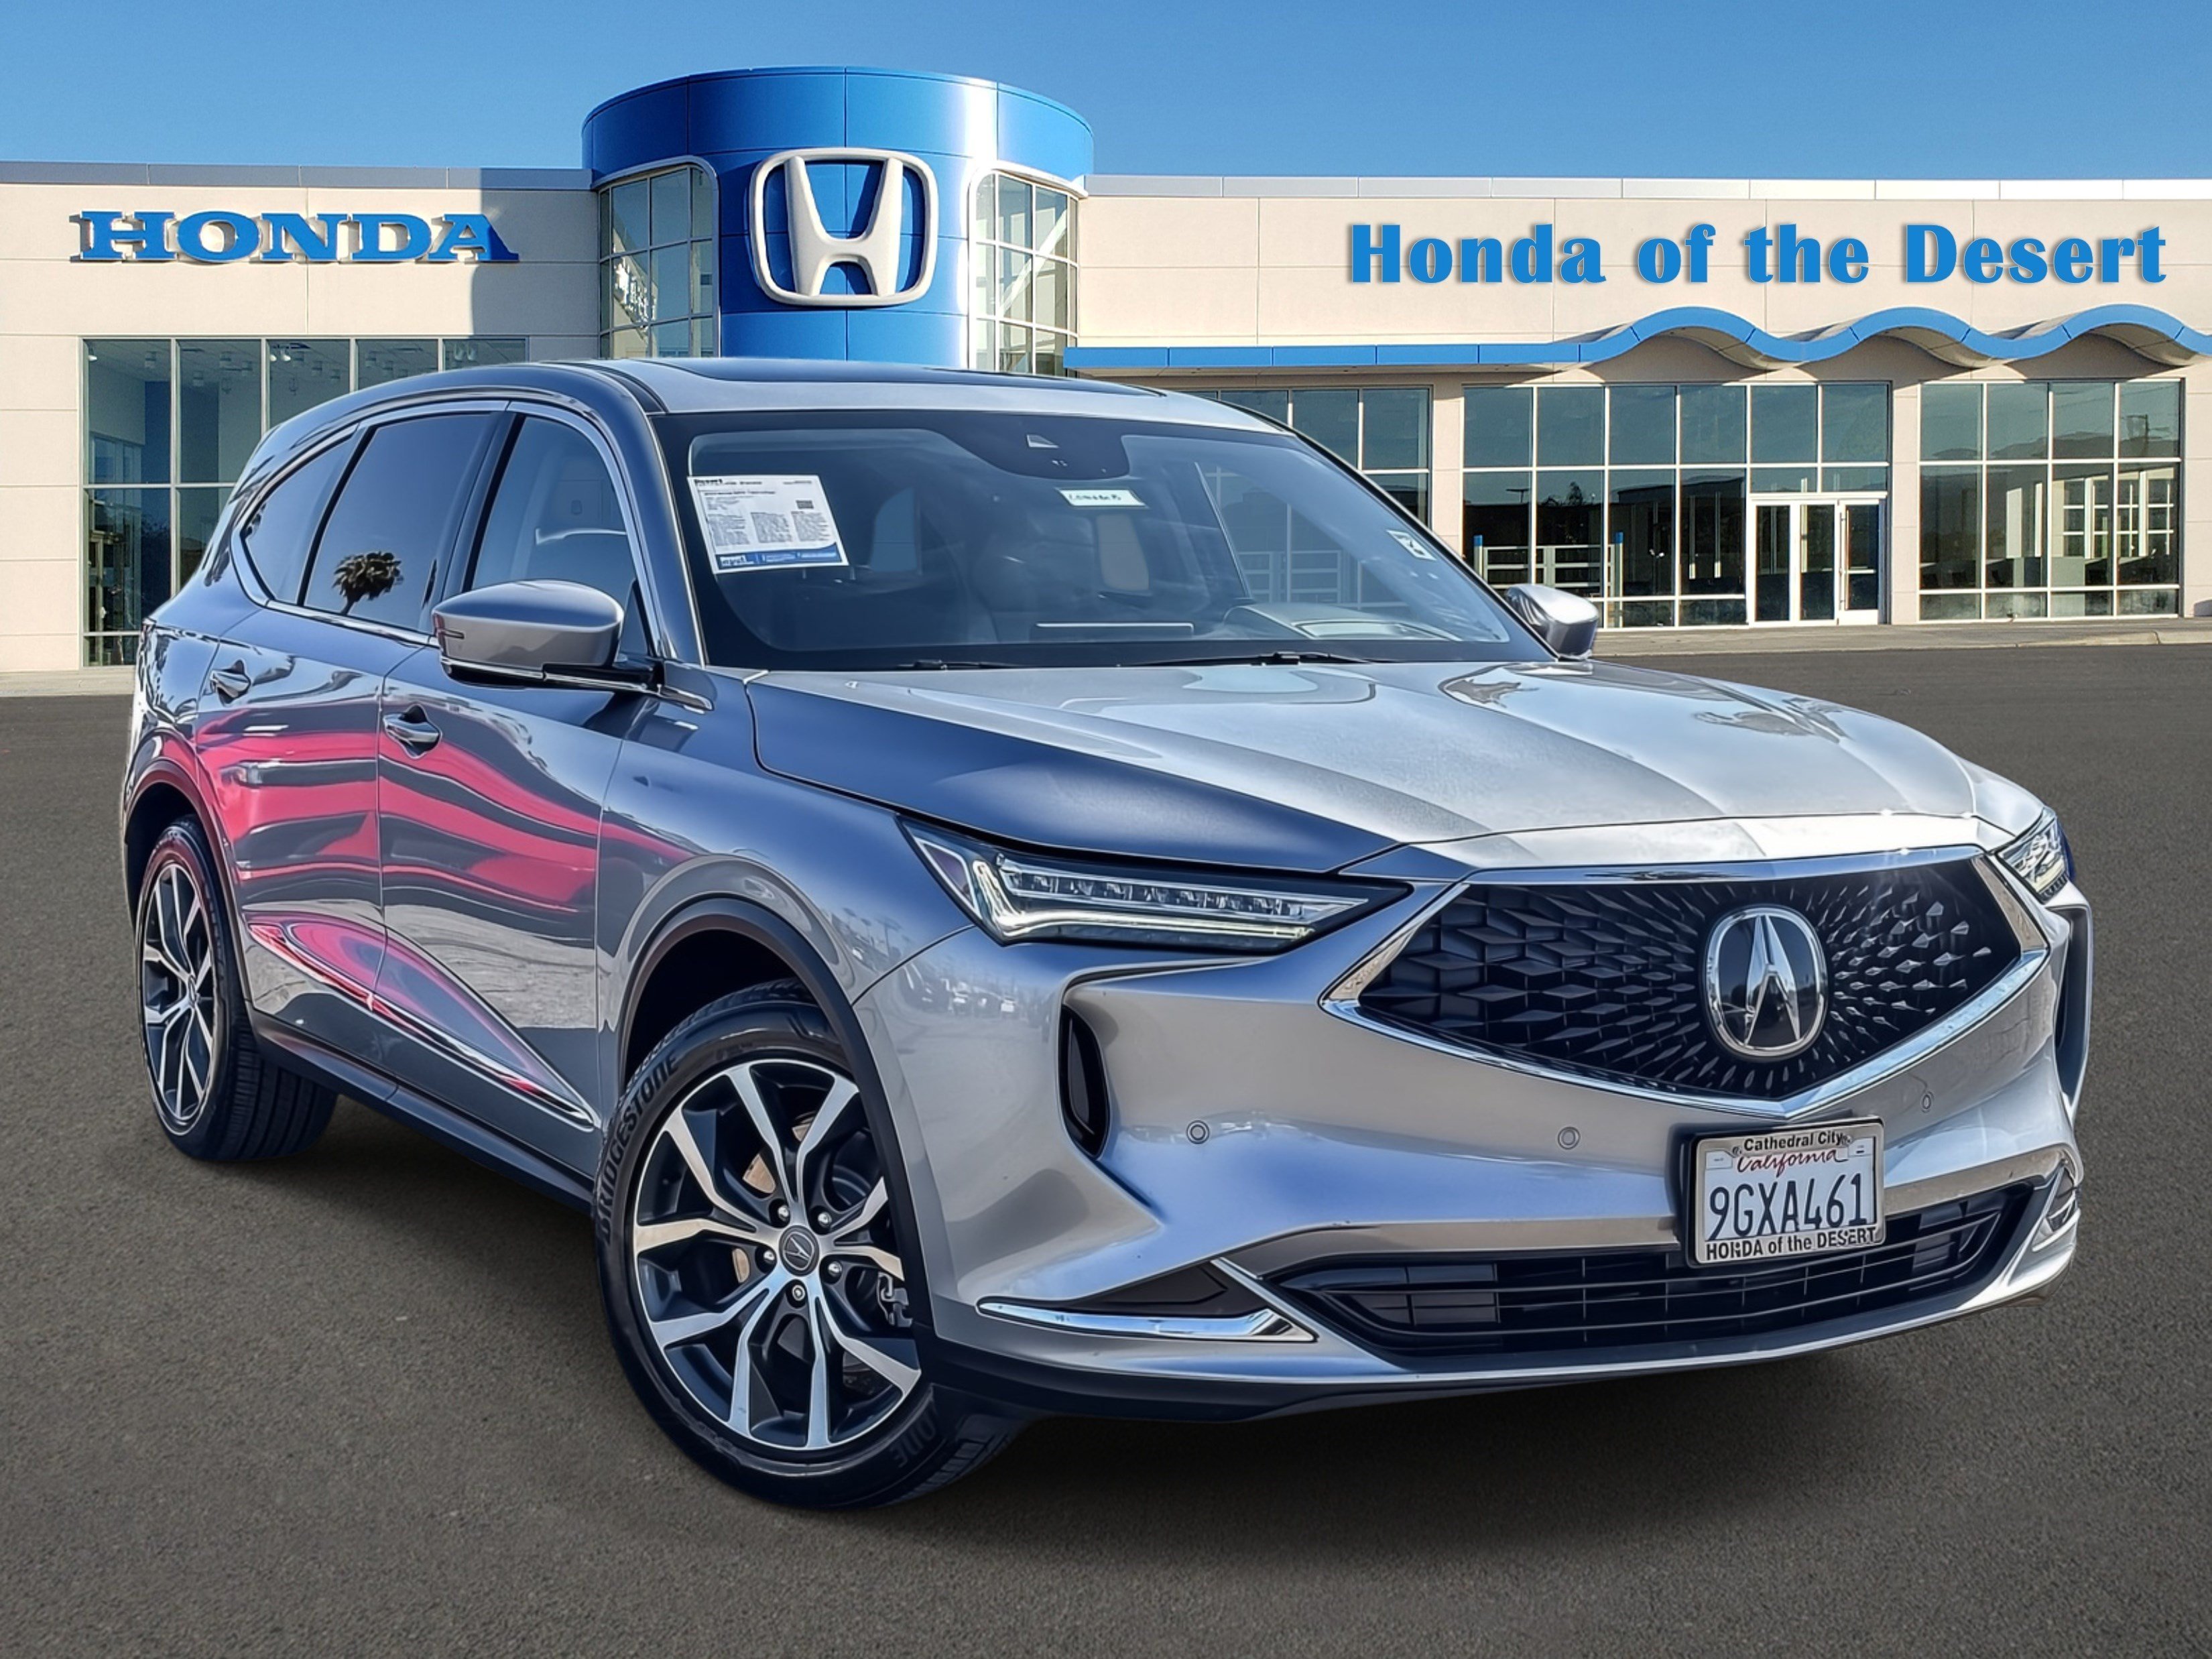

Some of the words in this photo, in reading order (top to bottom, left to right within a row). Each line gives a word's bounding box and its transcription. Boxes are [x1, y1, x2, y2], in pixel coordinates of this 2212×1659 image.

[78, 210, 520, 263] HONDA
[1352, 223, 1607, 284] Honda
[1638, 223, 1716, 284] of
[1743, 223, 1869, 284] the
[1906, 223, 2166, 284] Desert
[599, 1056, 678, 1245] BRIDGESTONE
[1737, 1149, 1849, 1178] California
[1744, 1133, 1814, 1151] Cathedral
[1818, 1130, 1844, 1146] City
[1707, 1172, 1868, 1241] 9GXA461
[1706, 1239, 1764, 1261] HONDA
[1768, 1236, 1783, 1254] of
[1788, 1234, 1813, 1251] the
[1817, 1227, 1877, 1248] DESERT
